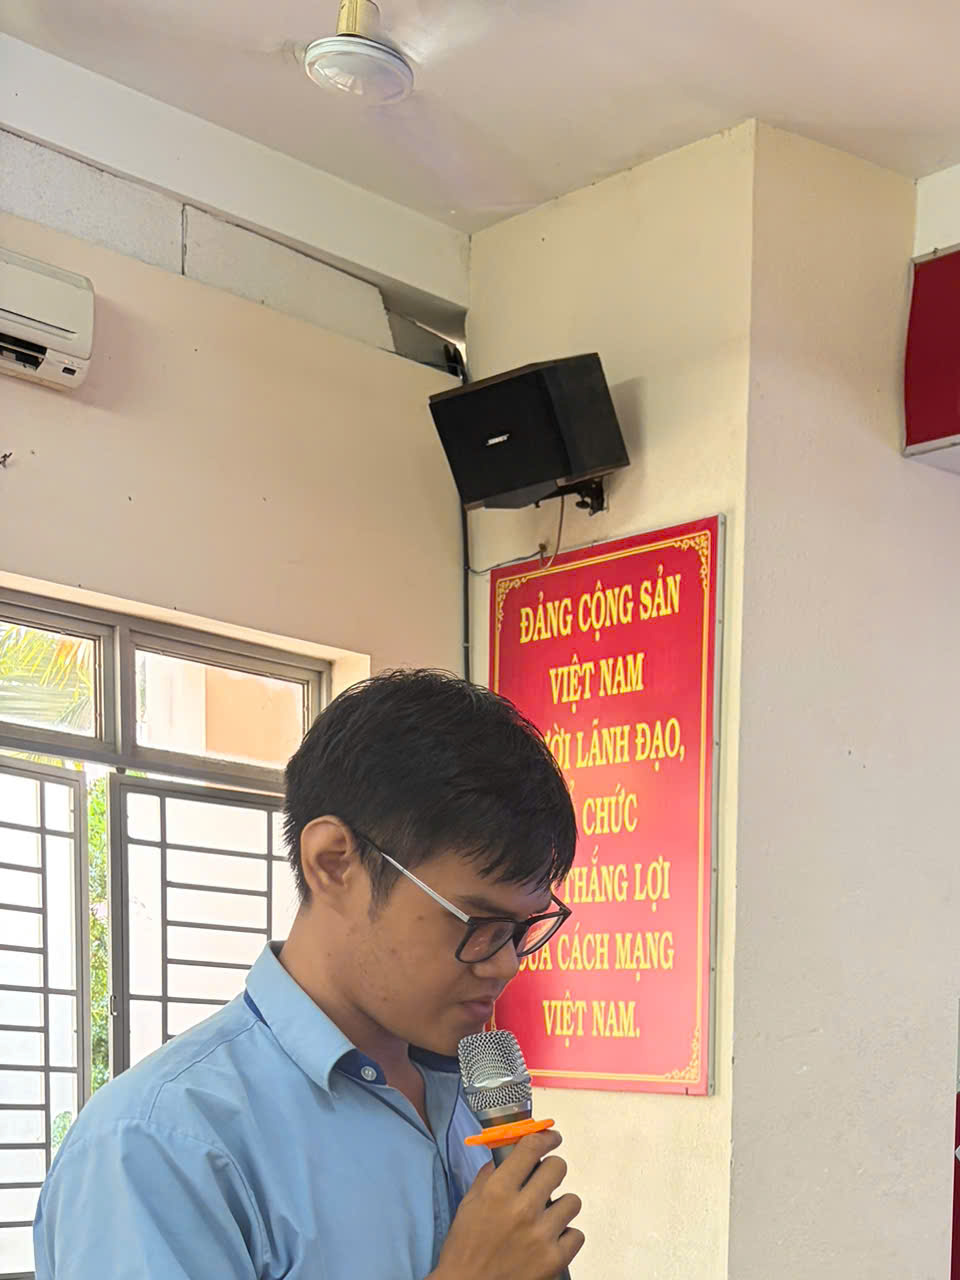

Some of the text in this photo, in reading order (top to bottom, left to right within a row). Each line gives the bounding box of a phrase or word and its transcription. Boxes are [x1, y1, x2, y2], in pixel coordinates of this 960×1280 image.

[519, 564, 682, 644] ĐẢNG CỘNG SẢN
[549, 652, 646, 714] VIỆT NAM
[635, 717, 685, 772] ĐẠO,
[582, 783, 638, 836] CHỨC
[563, 844, 671, 913] THẮNG LỢI
[557, 922, 610, 971] CÁCH
[615, 931, 675, 982] MẠNG
[542, 991, 640, 1048] VIỆT NAM.
